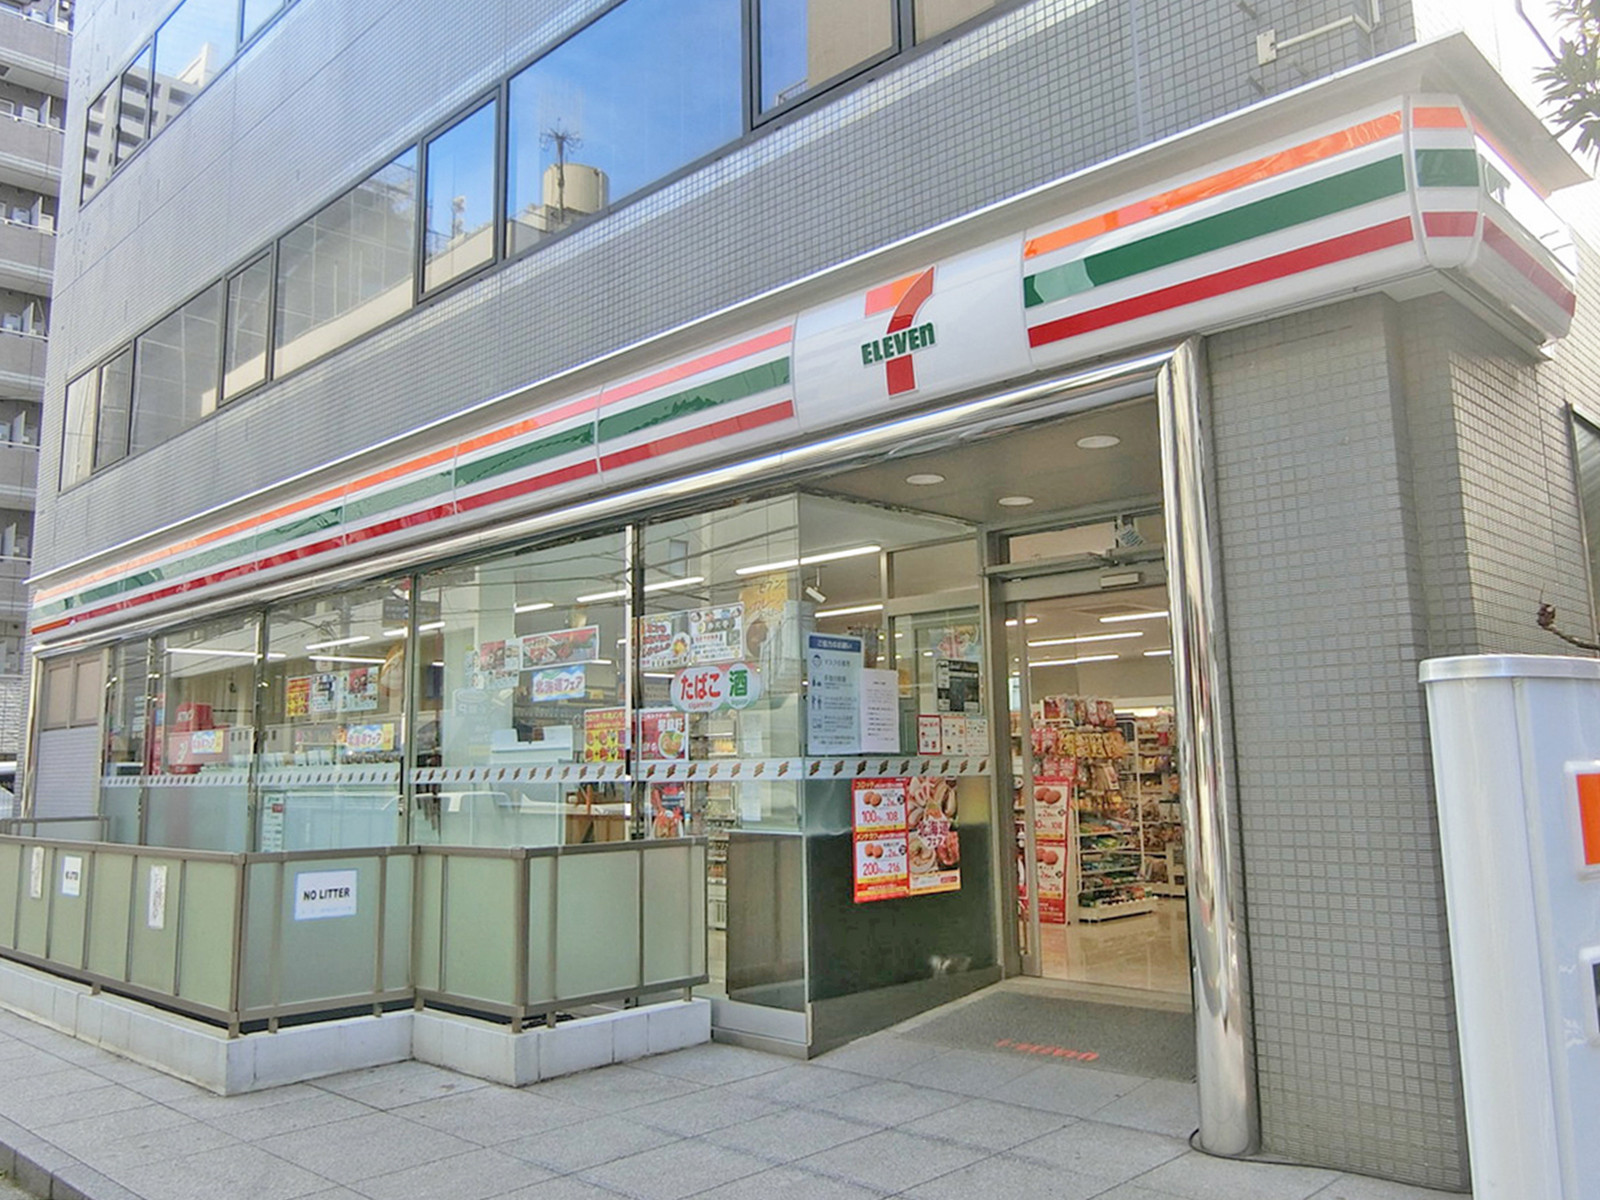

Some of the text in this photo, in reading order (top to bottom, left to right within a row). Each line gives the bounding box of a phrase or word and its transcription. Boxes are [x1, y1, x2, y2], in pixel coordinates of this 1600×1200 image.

[865, 266, 934, 396] 7
[534, 675, 583, 695] 北海道フェア
[680, 671, 721, 700] たばこ
[729, 669, 748, 697] 酒
[917, 820, 950, 837] 北海道
[303, 887, 350, 901] NO LITTER
